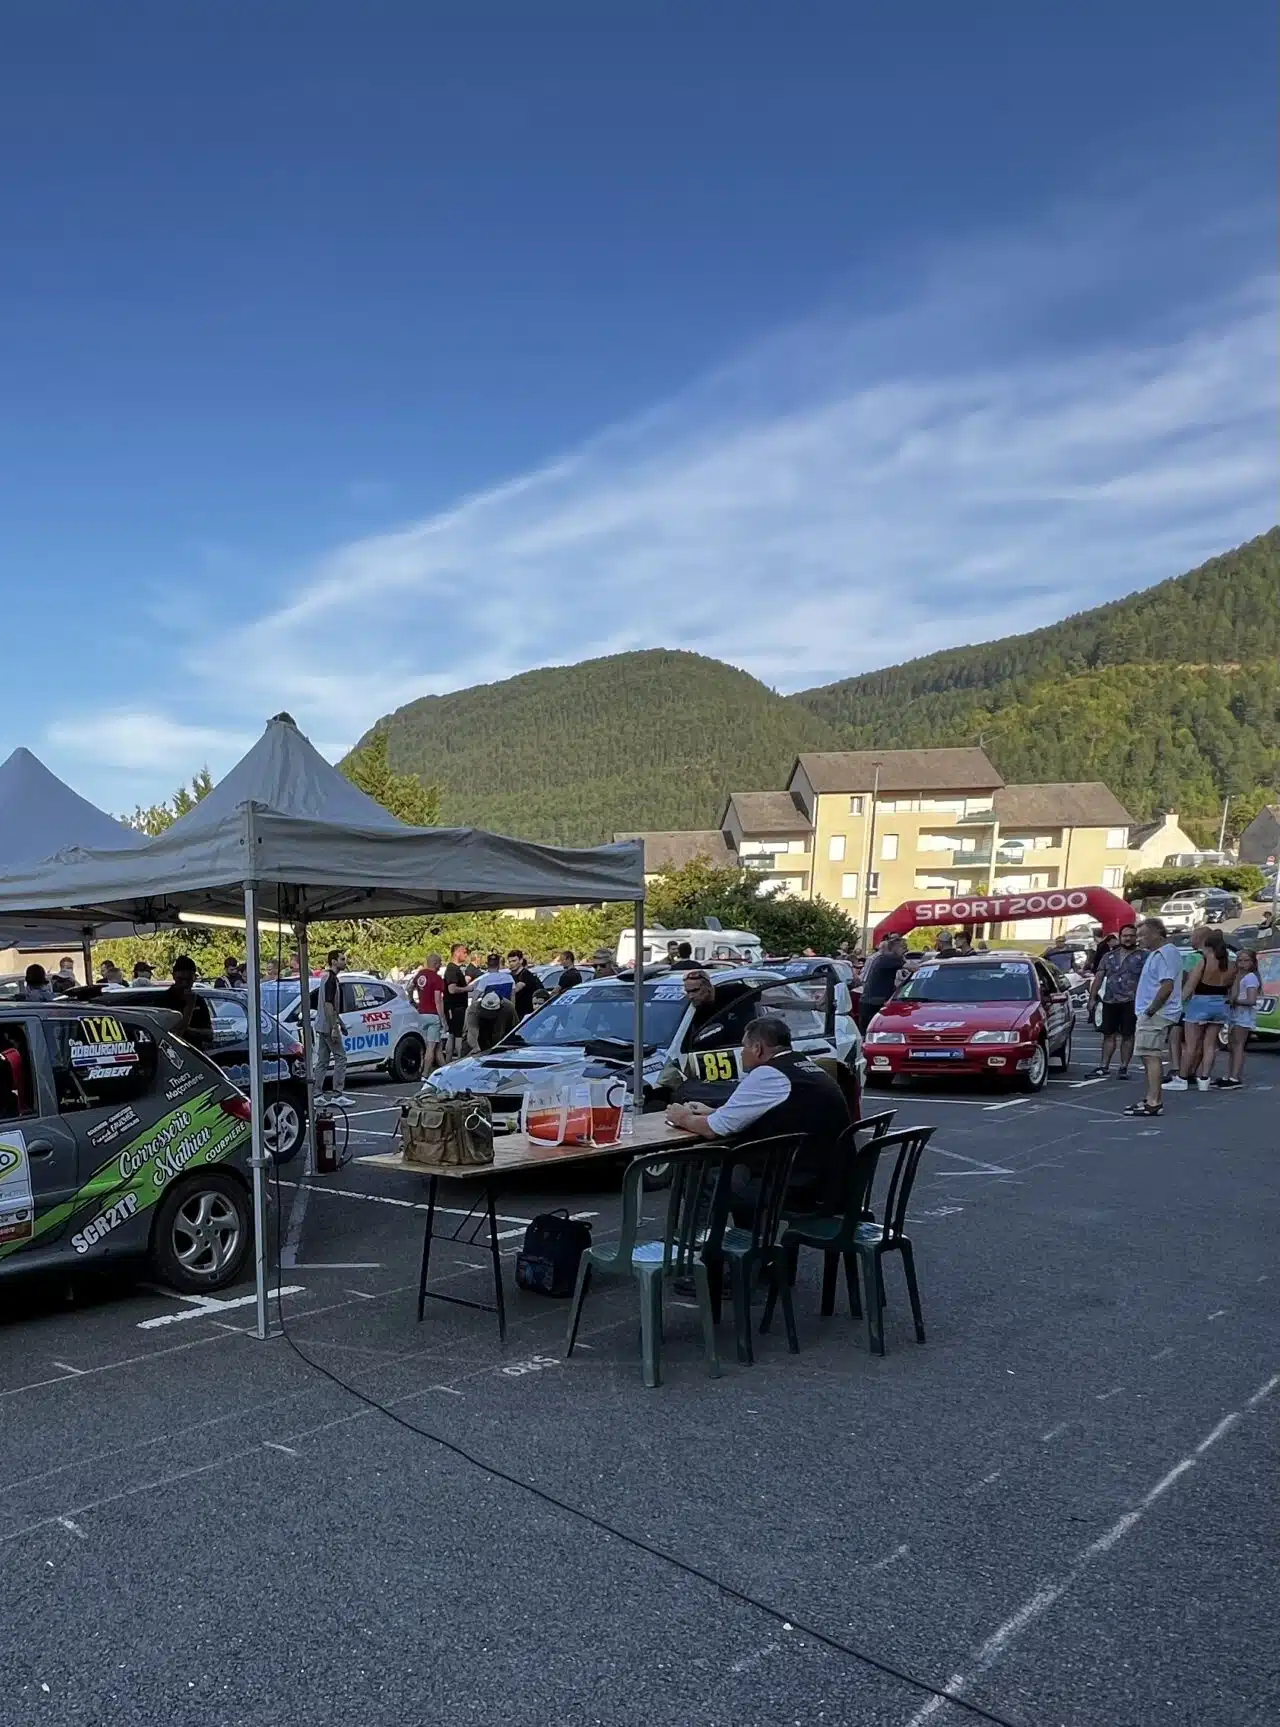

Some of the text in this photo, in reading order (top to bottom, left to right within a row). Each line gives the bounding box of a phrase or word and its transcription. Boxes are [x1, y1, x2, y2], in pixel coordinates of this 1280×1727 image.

[360, 1010, 392, 1023] MRF
[344, 1032, 389, 1052] SIDVIN
[89, 1065, 133, 1080] ROBERT
[703, 1051, 733, 1081] 85
[120, 1110, 191, 1179] Carrosserie
[153, 1126, 212, 1187] Mathieu
[205, 1121, 246, 1163] COURPIERE
[71, 1191, 138, 1254] SCR2TP
